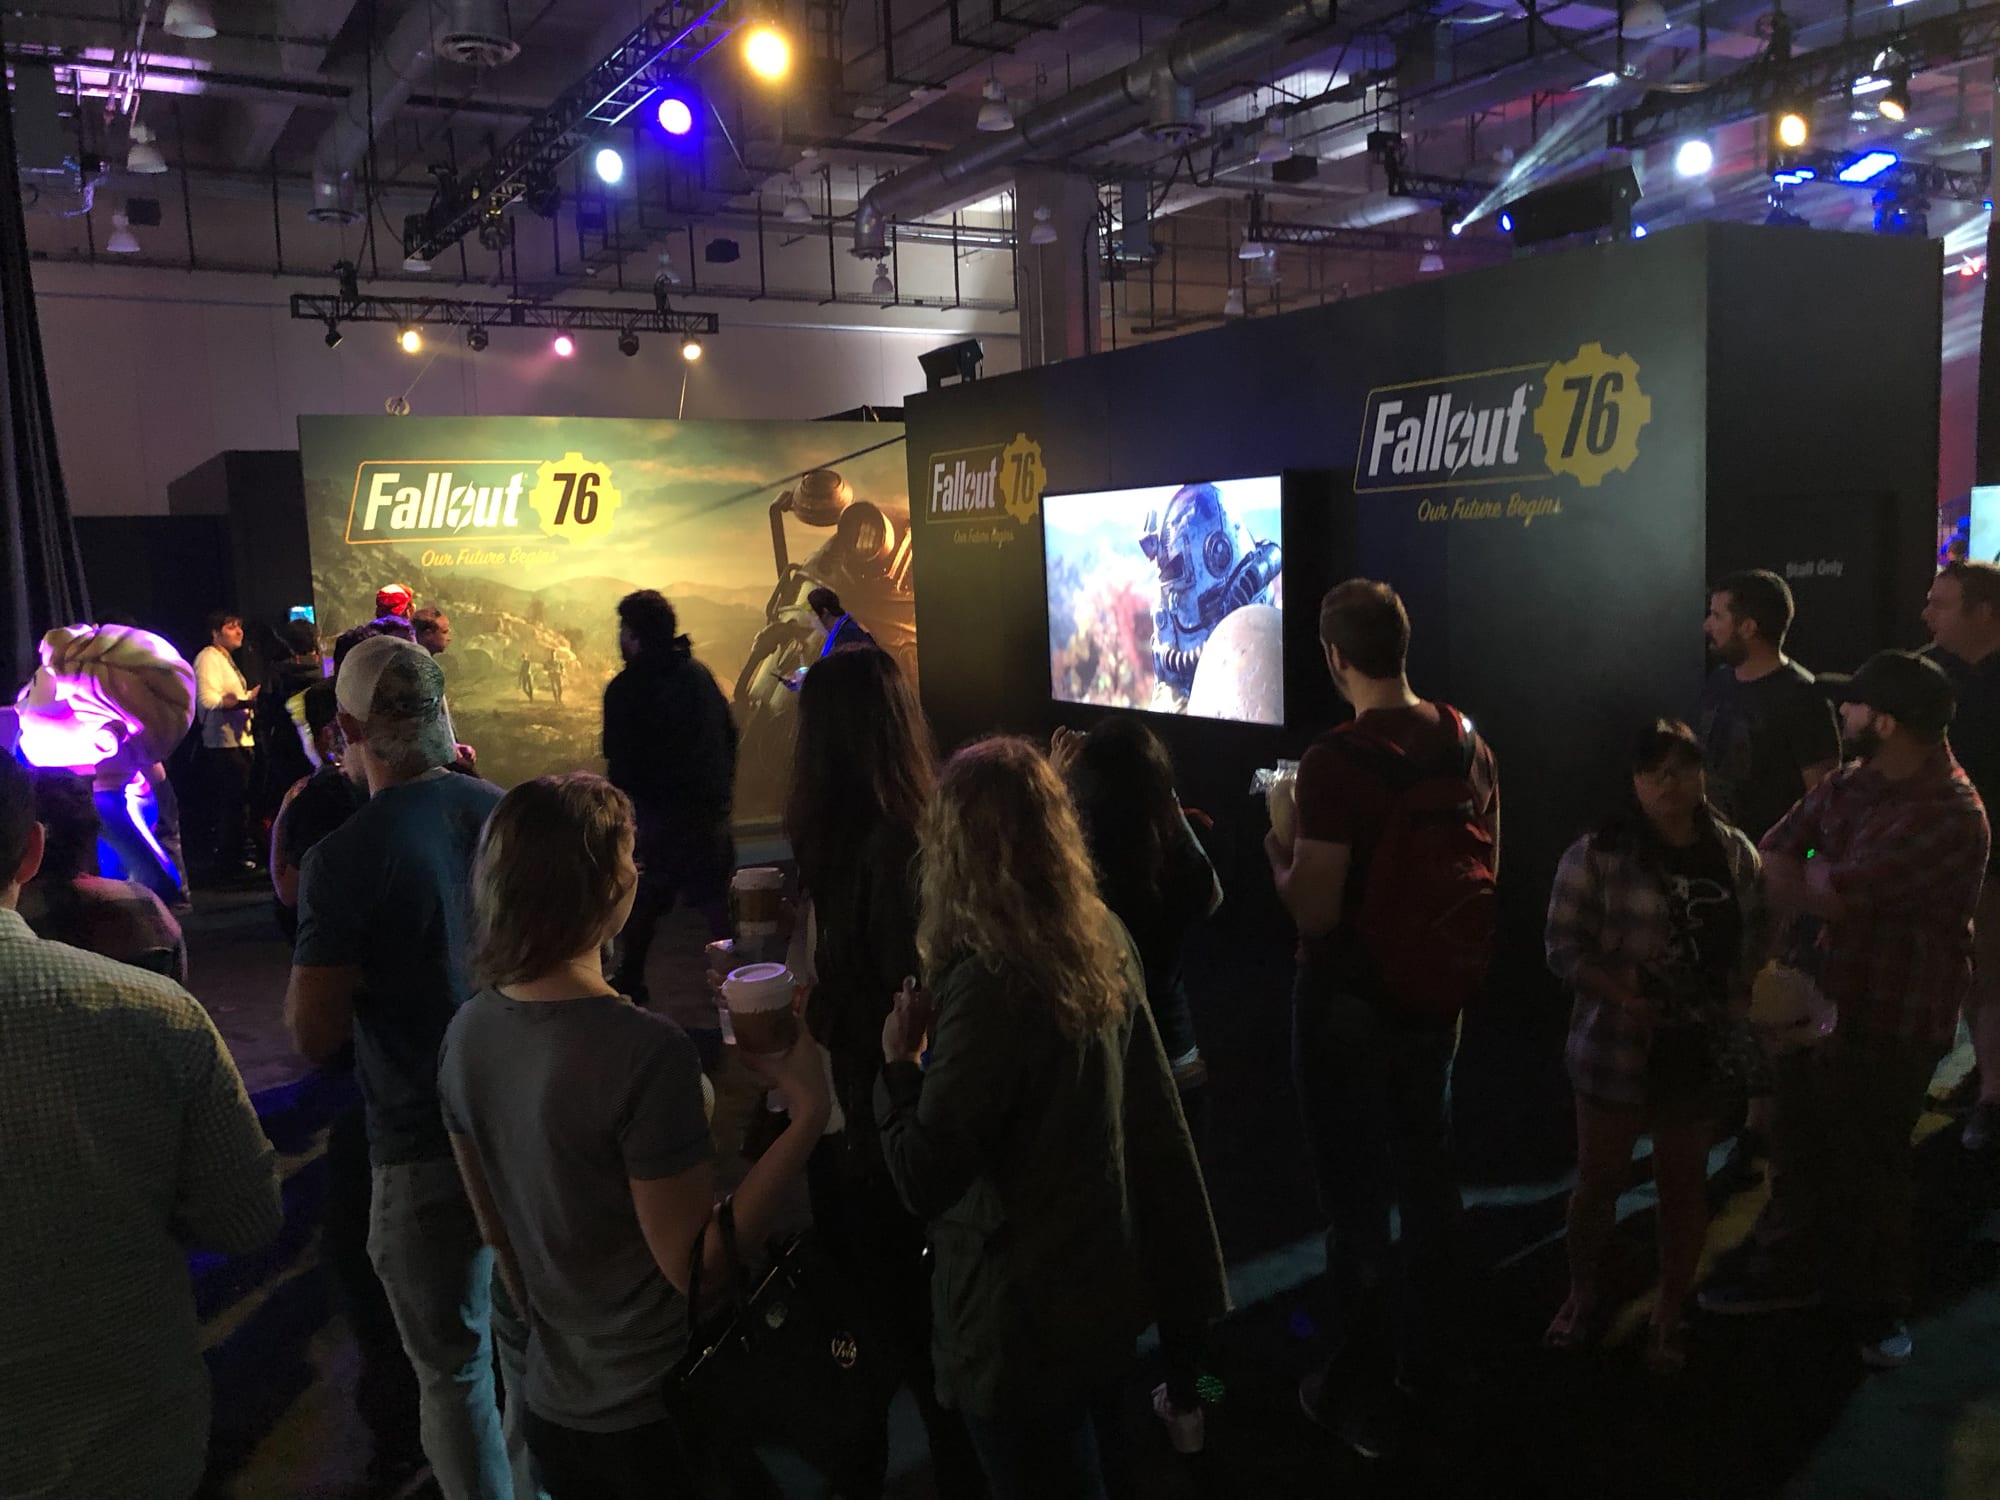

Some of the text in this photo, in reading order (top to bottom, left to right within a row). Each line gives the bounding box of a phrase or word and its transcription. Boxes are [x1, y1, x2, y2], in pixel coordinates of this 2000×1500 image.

[1367, 371, 1624, 477] Fallout 76
[363, 472, 601, 533] Fallout 76
[931, 451, 1036, 513] Fallout 76
[1417, 492, 1563, 527] Our Future Begins
[421, 546, 560, 572] Our Future Begins
